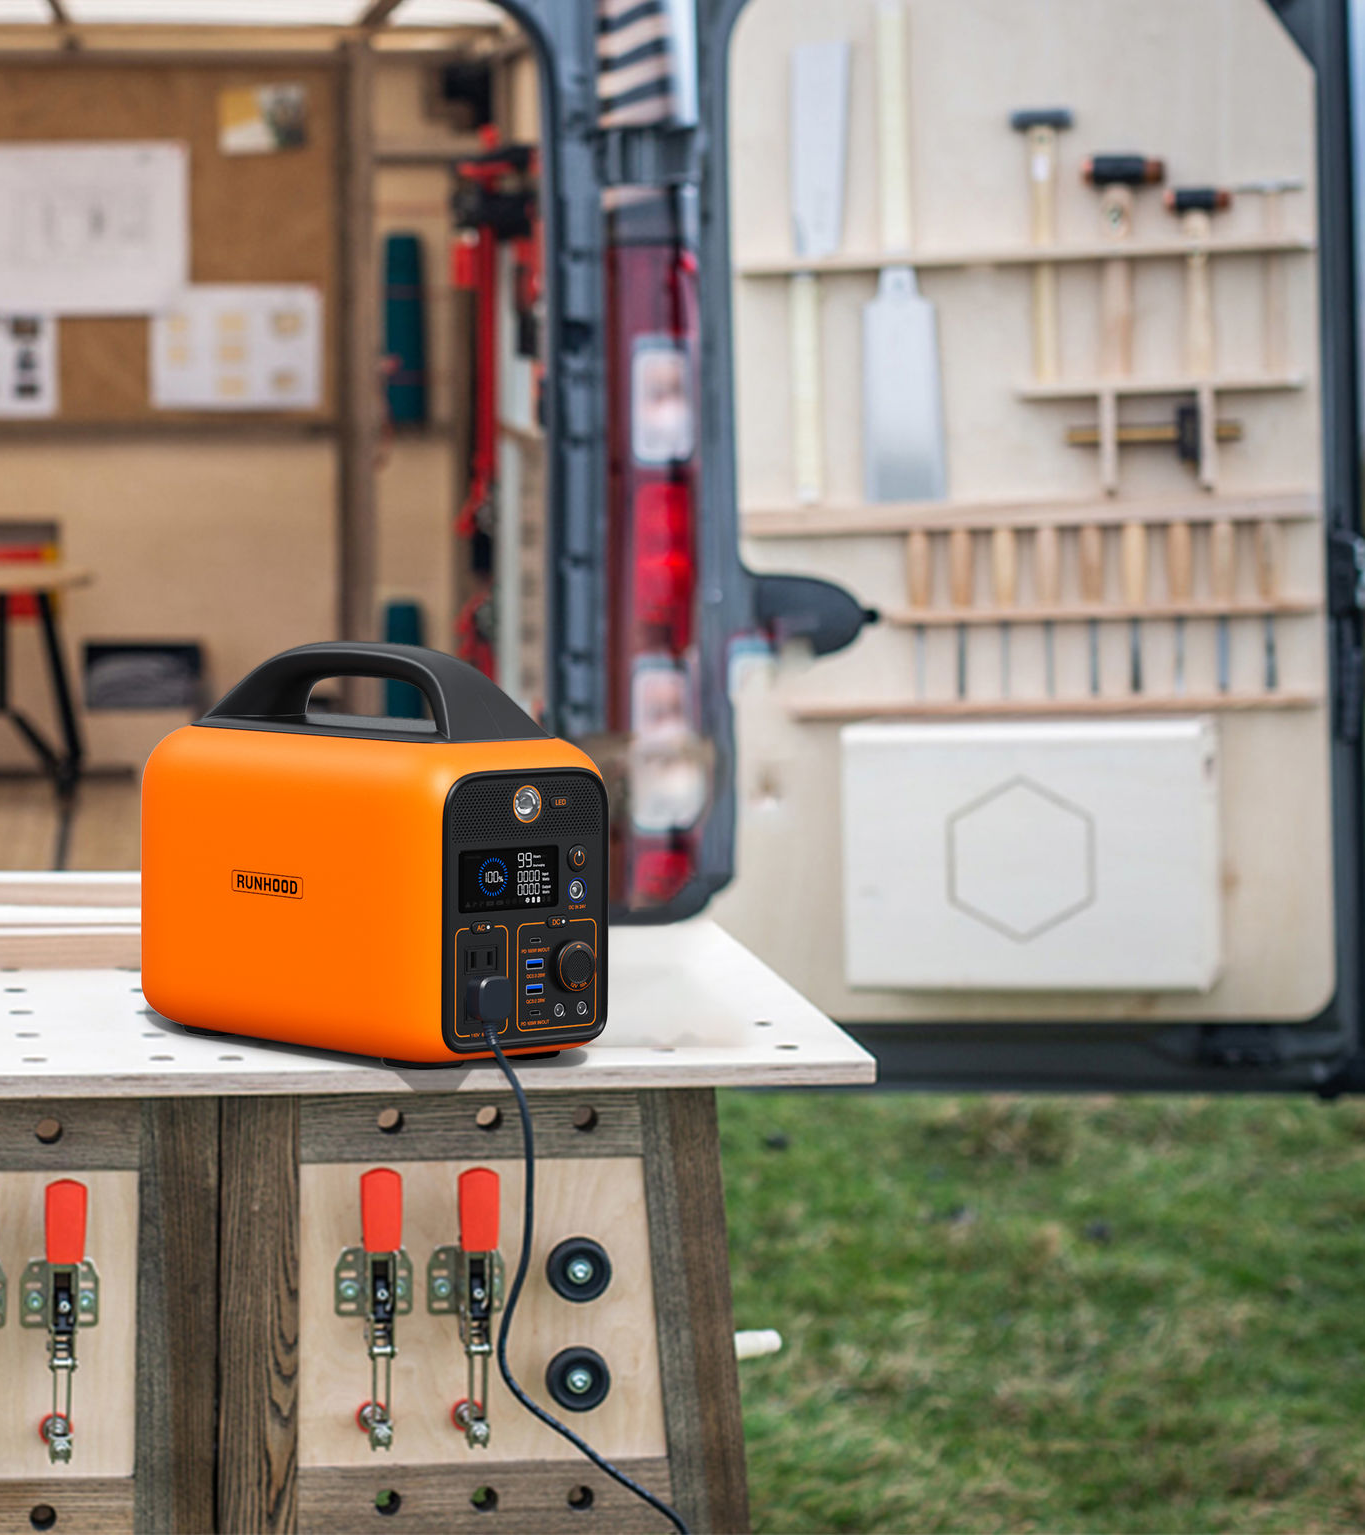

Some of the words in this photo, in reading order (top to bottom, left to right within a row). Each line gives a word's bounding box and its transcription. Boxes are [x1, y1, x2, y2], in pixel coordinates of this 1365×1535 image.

[554, 798, 567, 806] LED
[517, 852, 533, 868] 99
[485, 870, 504, 884] 100%
[236, 873, 298, 895] RUNHOOD
[551, 918, 561, 926] DC
[476, 924, 486, 932] AC
